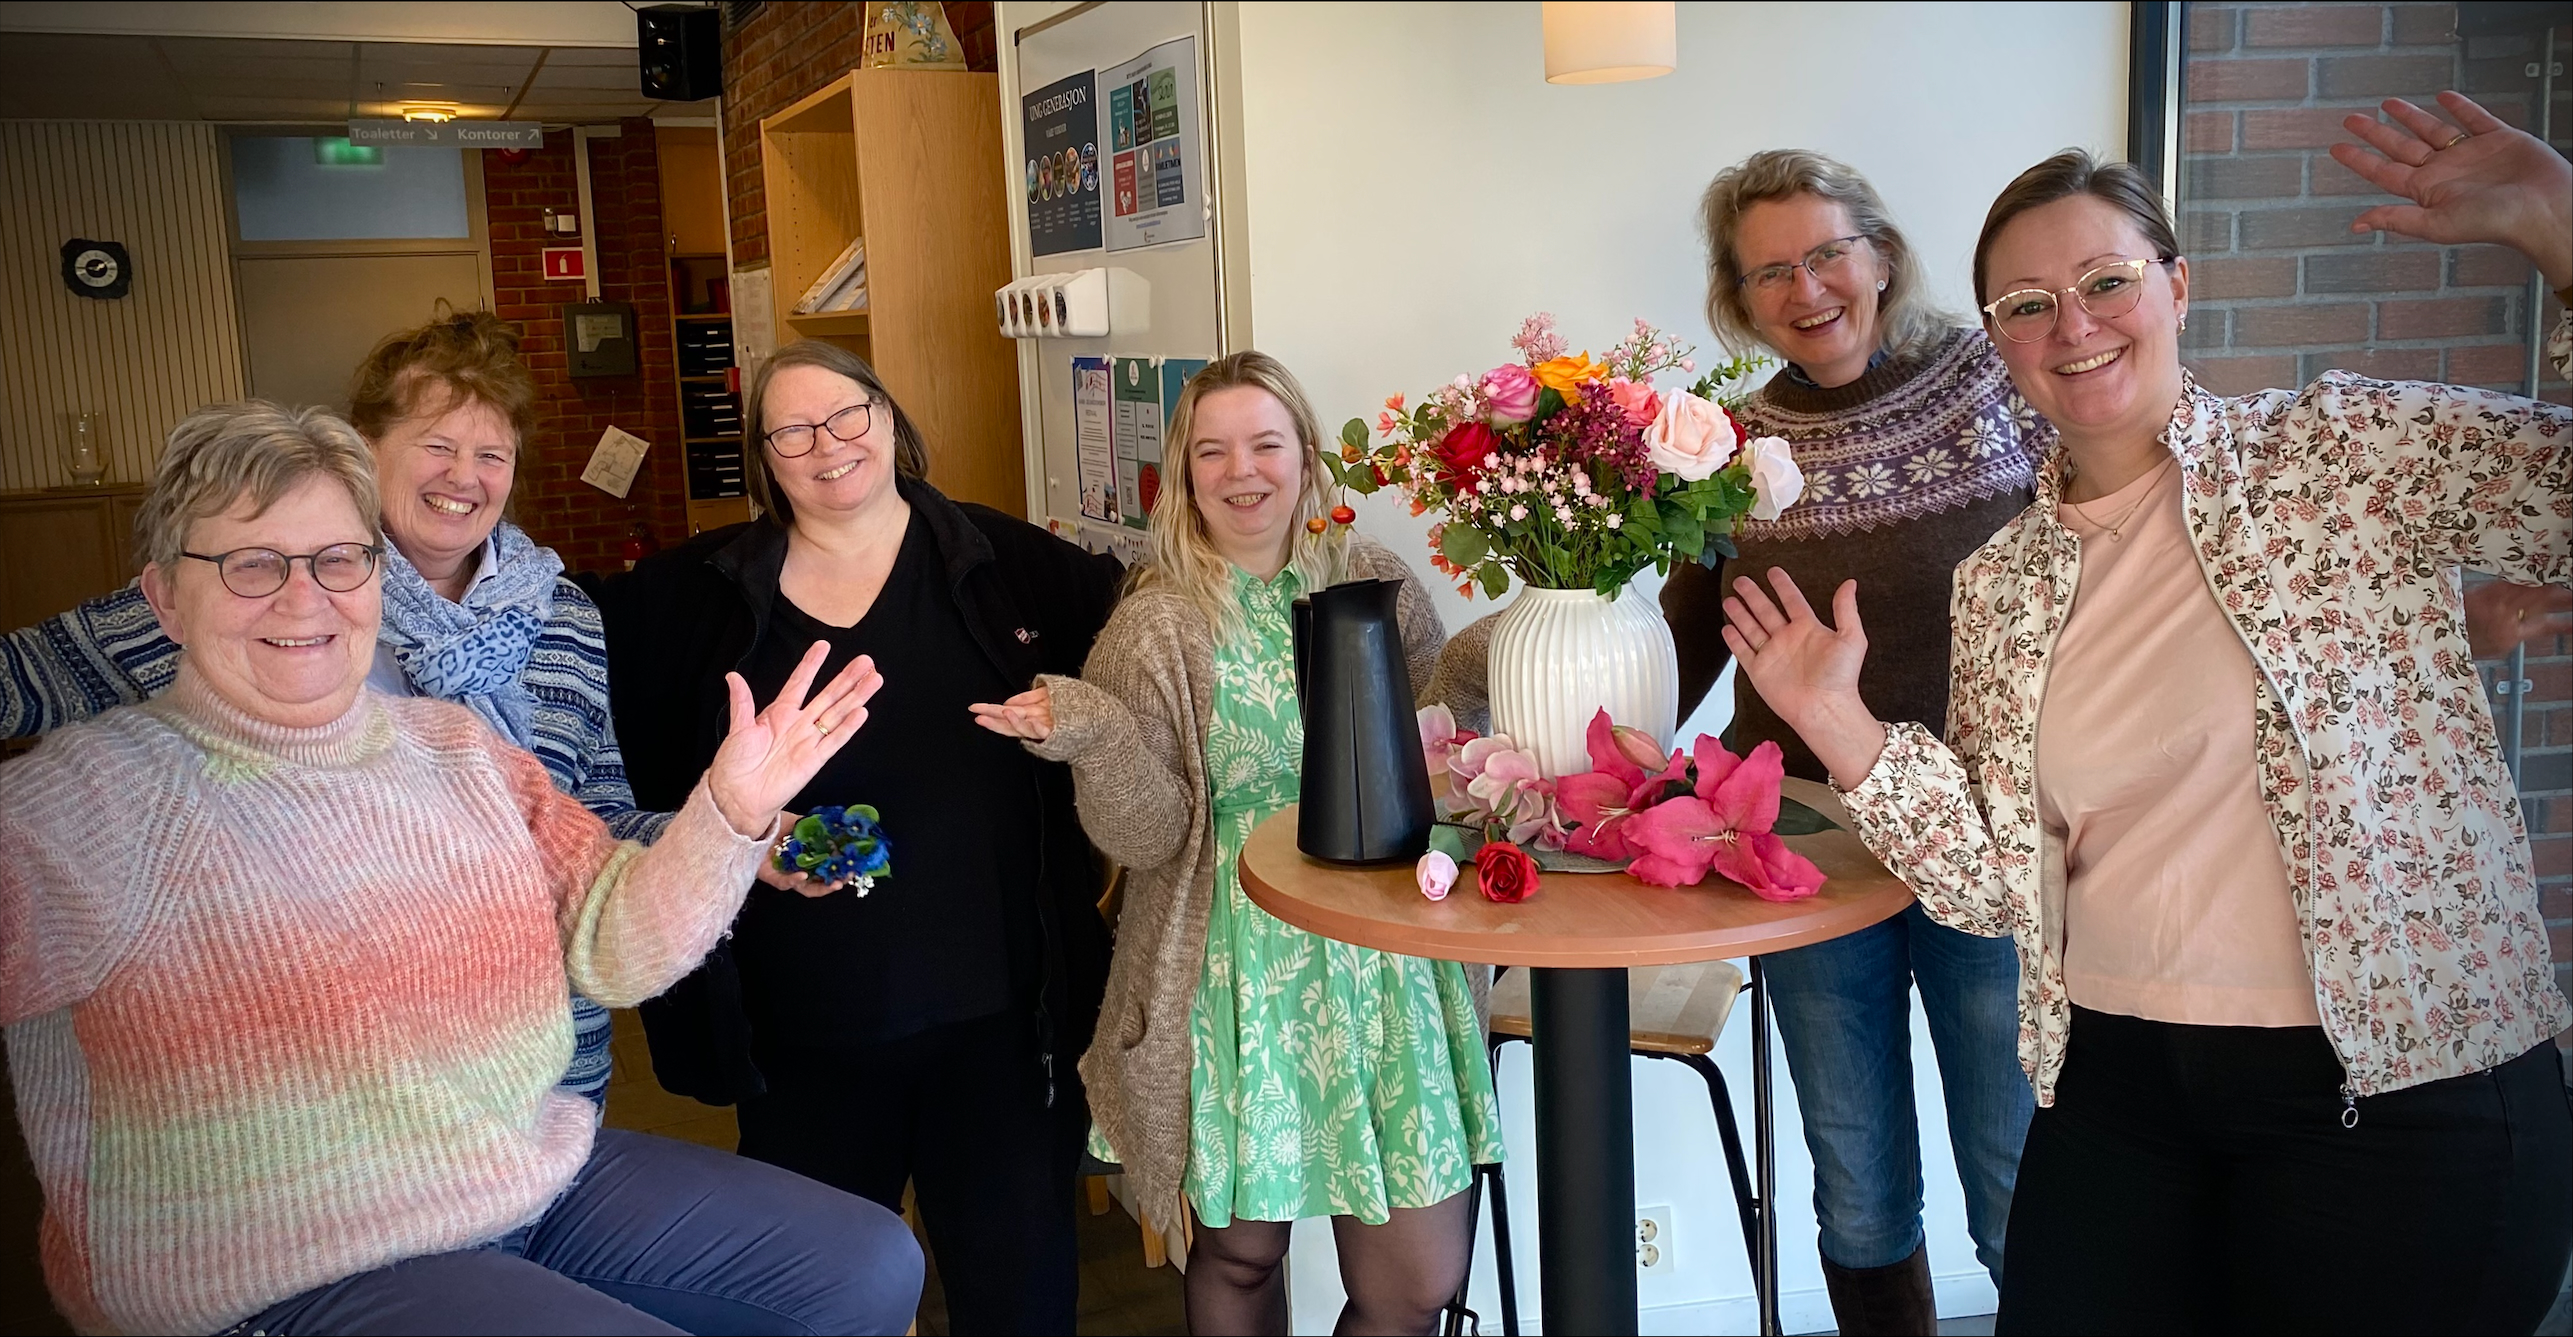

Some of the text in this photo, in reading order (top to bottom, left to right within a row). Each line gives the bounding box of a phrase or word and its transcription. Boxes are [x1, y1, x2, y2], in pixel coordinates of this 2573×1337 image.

[1029, 85, 1087, 122] UNG GENERASJON
[352, 128, 521, 141] Toaletter Kontorer
